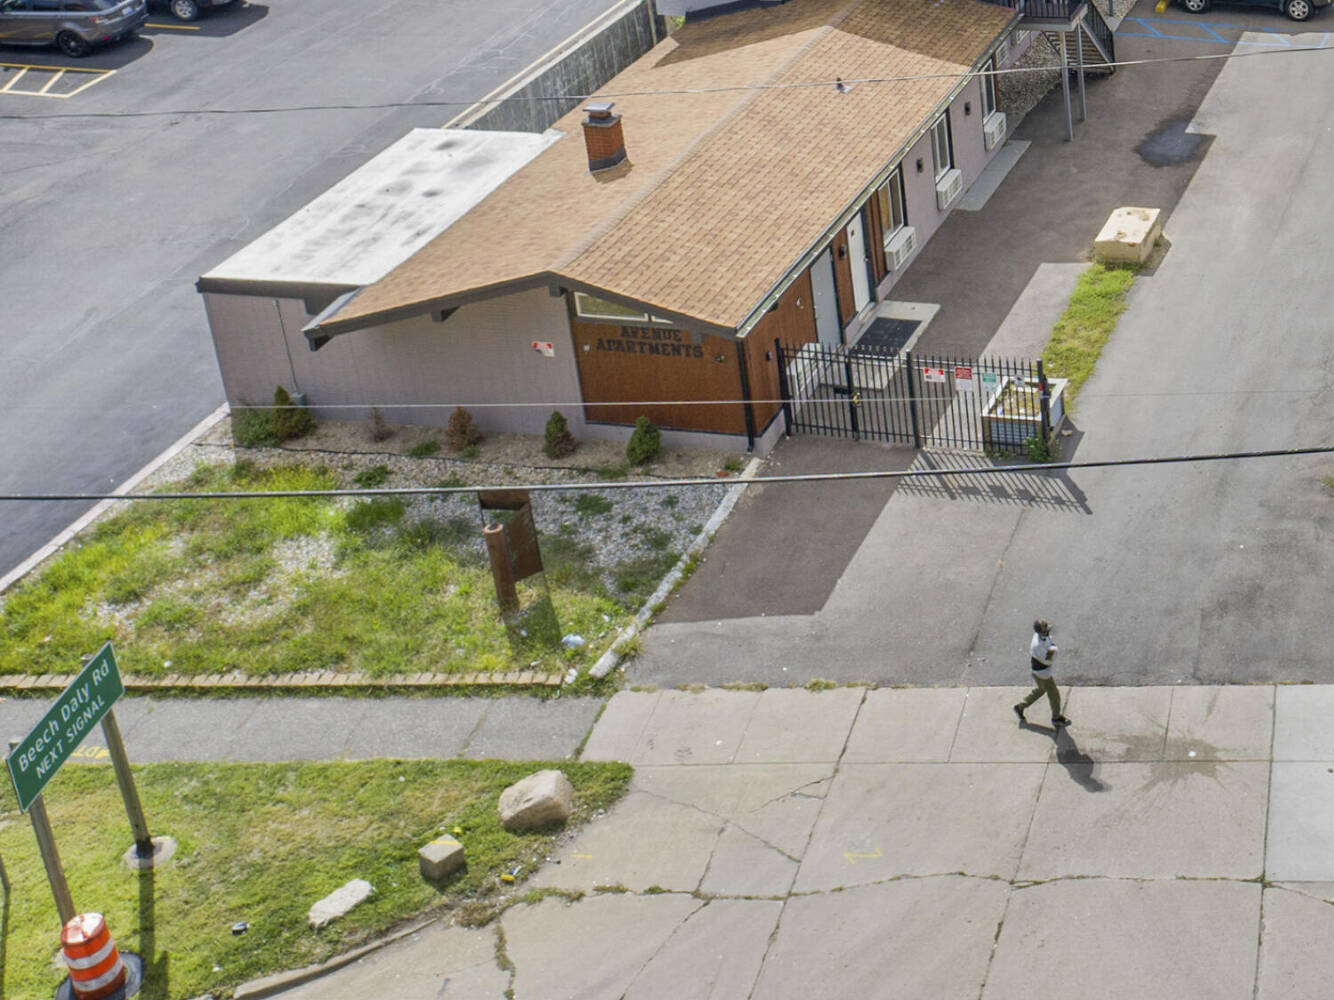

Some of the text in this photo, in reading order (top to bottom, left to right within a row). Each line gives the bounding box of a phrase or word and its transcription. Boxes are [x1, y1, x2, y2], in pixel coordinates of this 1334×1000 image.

[597, 338, 704, 358] APARTMENTS
[621, 326, 682, 342] AVENUE
[19, 720, 59, 772] Beech
[61, 682, 91, 722] Daly
[92, 658, 110, 686] Rd
[36, 739, 64, 779] NEXT
[66, 695, 105, 743] SIGNAL
